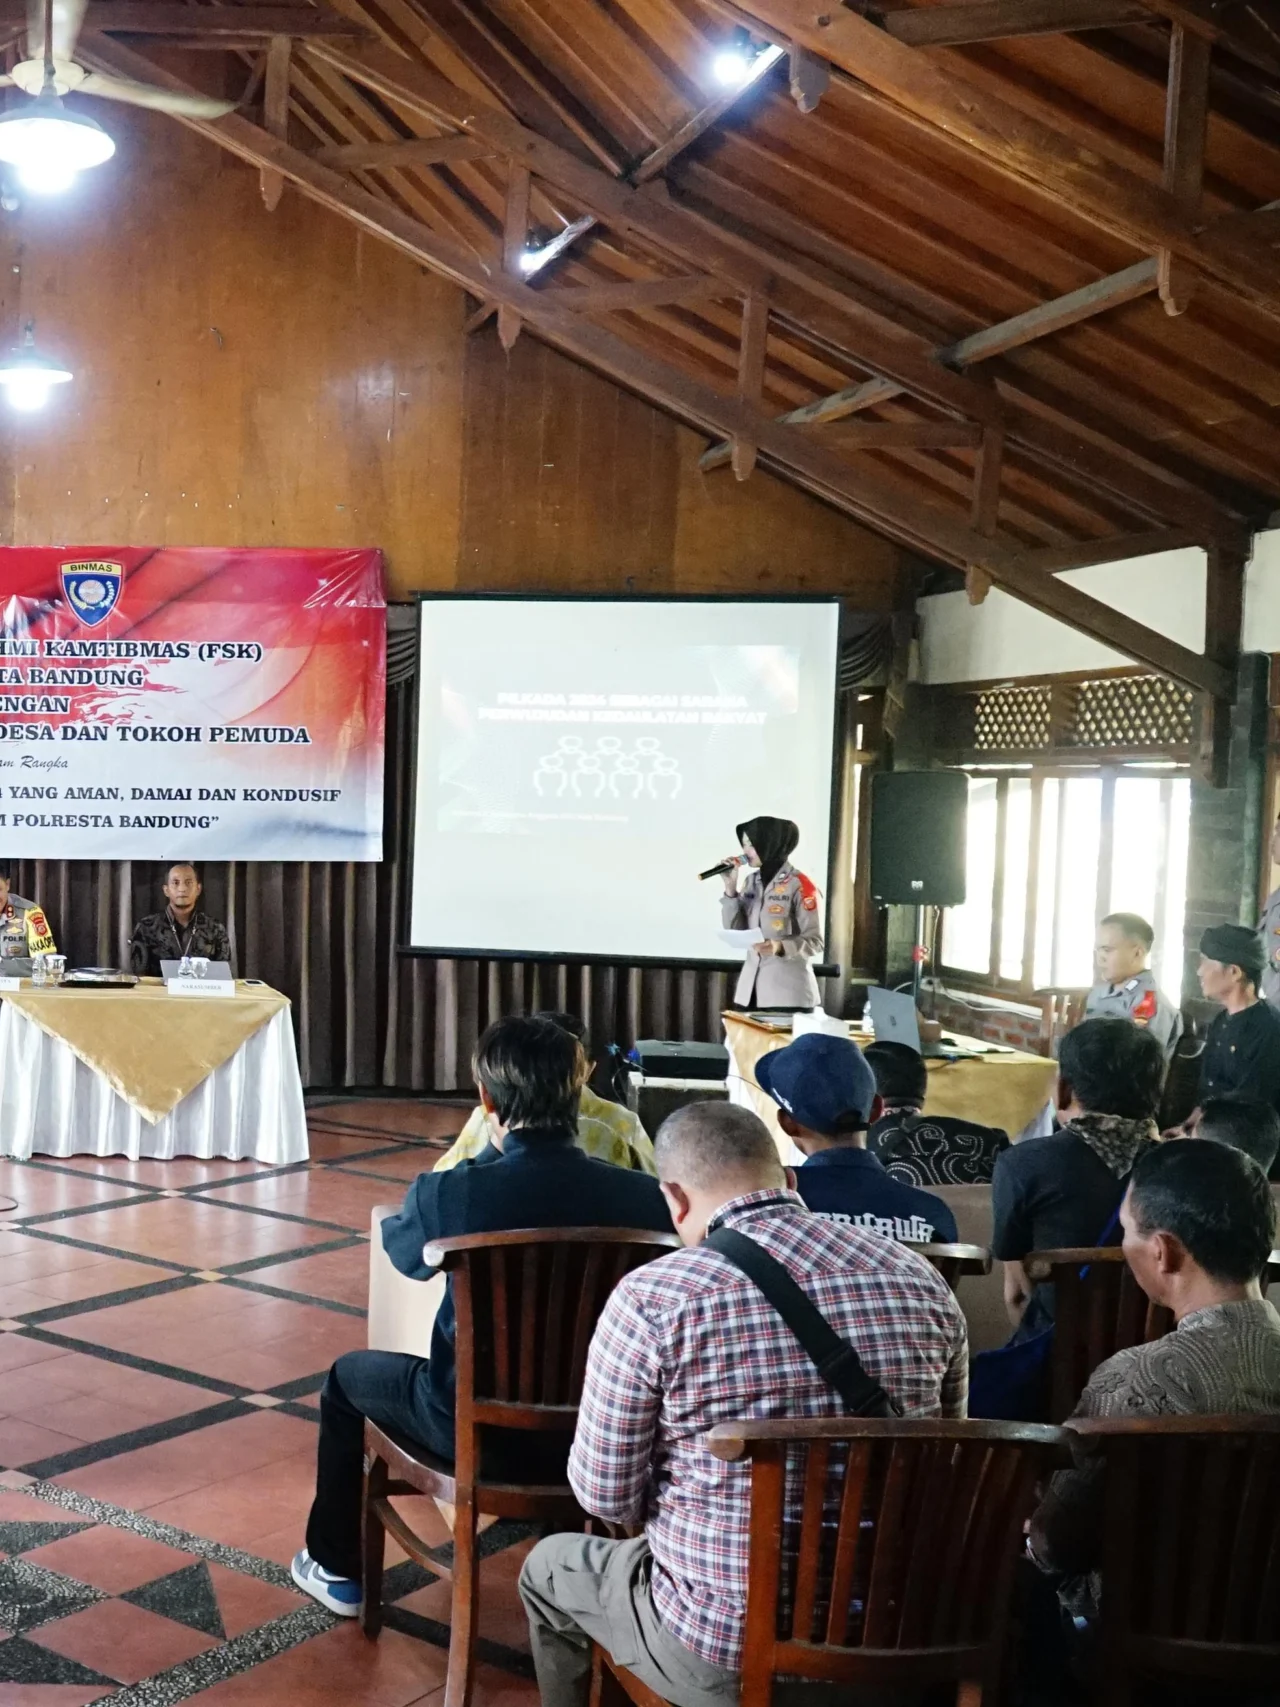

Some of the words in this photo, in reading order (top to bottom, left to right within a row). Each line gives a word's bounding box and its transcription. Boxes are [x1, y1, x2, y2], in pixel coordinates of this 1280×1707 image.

[70, 562, 113, 573] BINMAS
[45, 641, 190, 658] KAMTIBMAS
[198, 642, 263, 662] (FSK)
[29, 669, 144, 686] BANDUNG
[61, 726, 109, 741] DAN
[117, 726, 202, 742] TOKOH
[209, 727, 311, 743] PEMUDA
[20, 755, 69, 773] Rangka
[8, 787, 58, 800] YANG
[64, 787, 124, 802] AMAN,
[131, 788, 192, 801] DAMAI
[198, 788, 236, 801] DAN
[243, 789, 342, 803] KONDUSIF
[12, 814, 114, 828] POLRESTA
[119, 815, 220, 829] BANDUNG”
